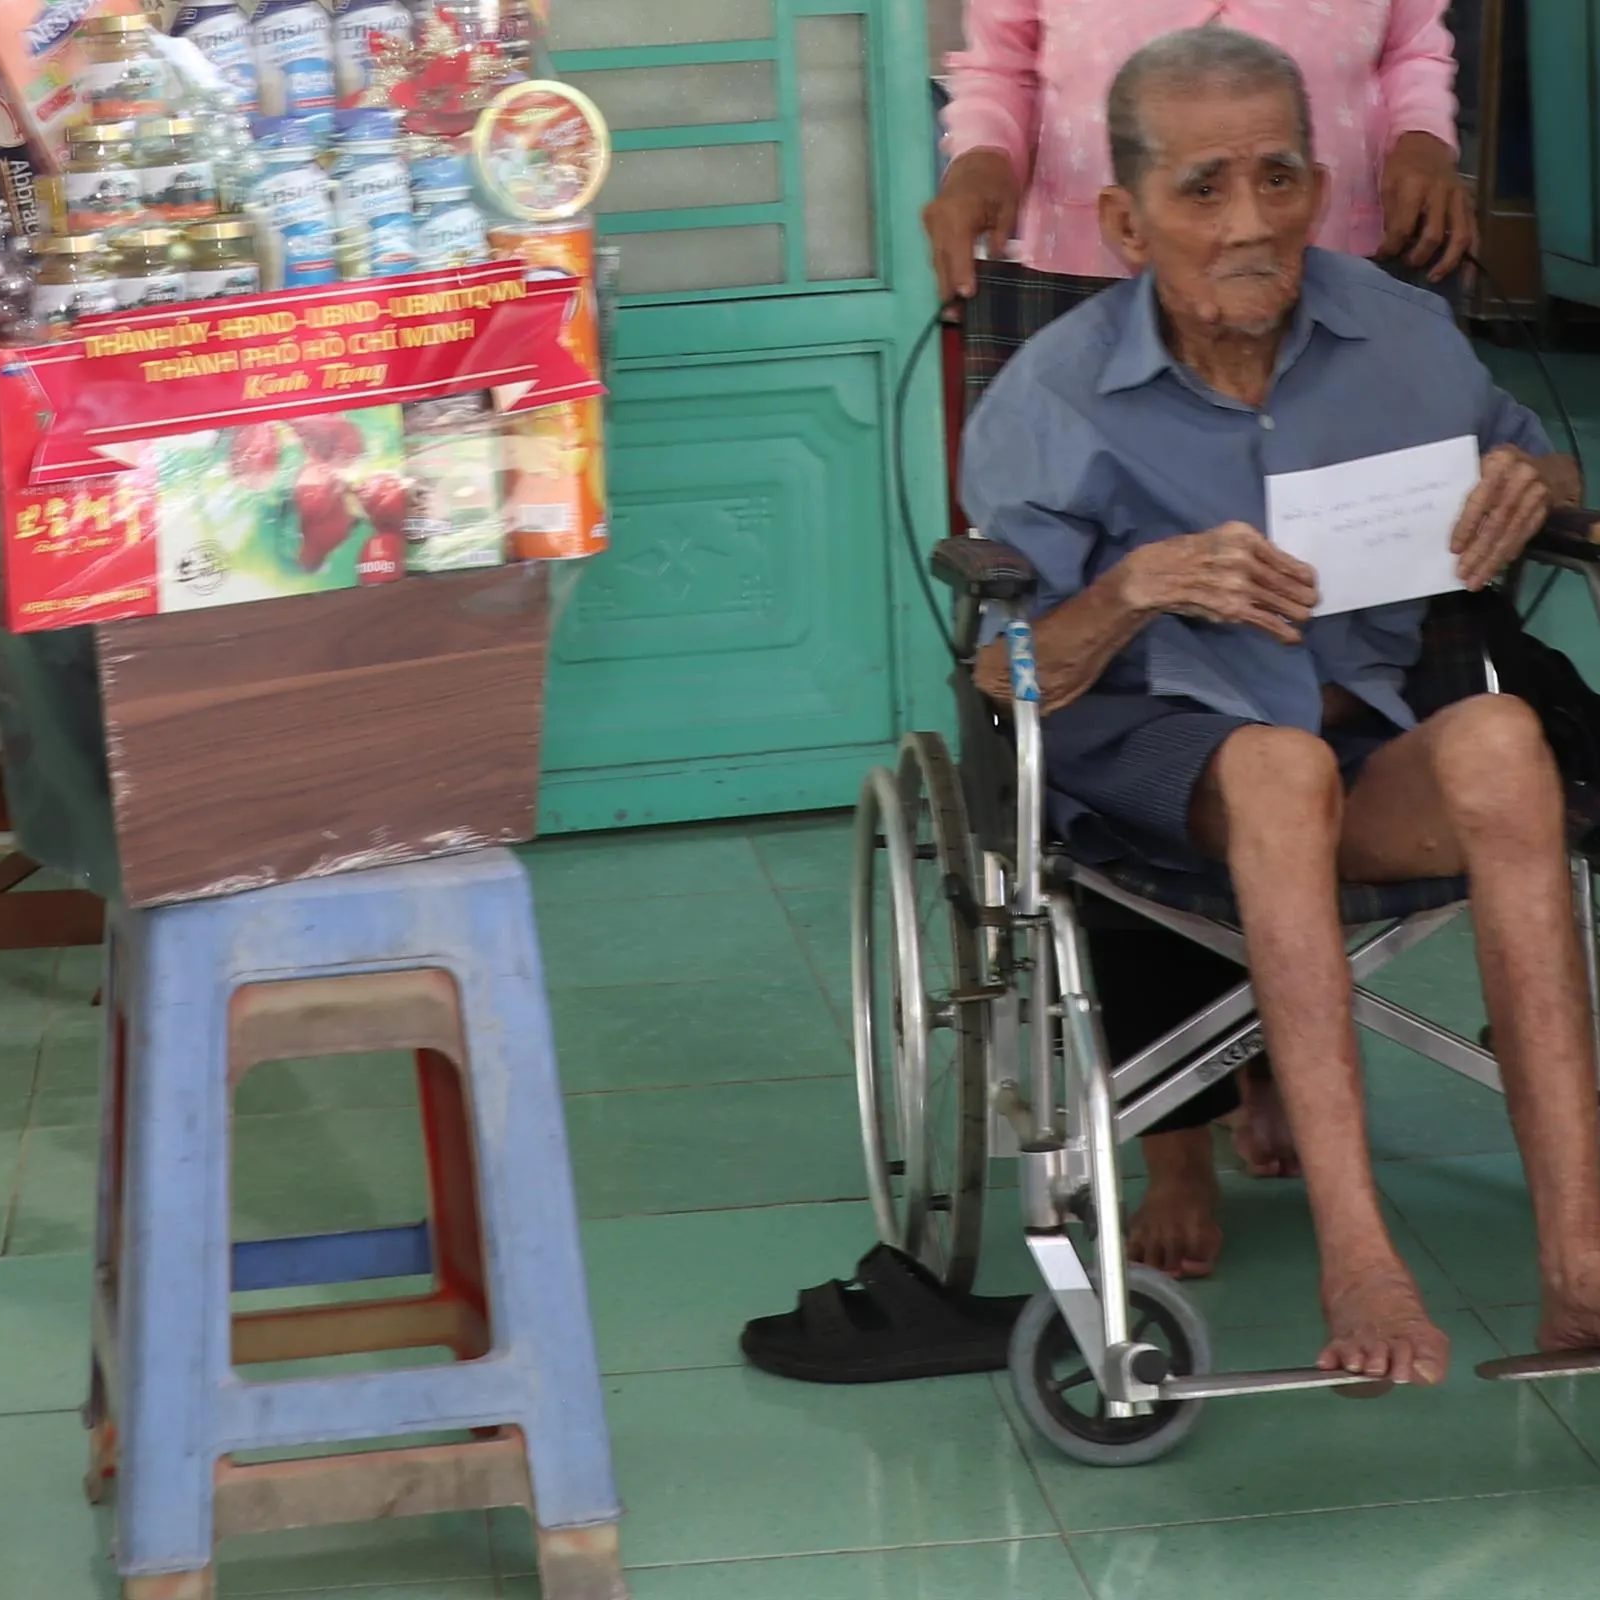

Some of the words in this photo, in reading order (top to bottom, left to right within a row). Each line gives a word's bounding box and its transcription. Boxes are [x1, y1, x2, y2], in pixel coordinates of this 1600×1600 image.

[139, 350, 239, 383] THÀNH
[240, 335, 301, 369] PHỐ
[301, 330, 346, 362] HỒ
[348, 323, 398, 355] CHÍ
[398, 318, 476, 348] MINH
